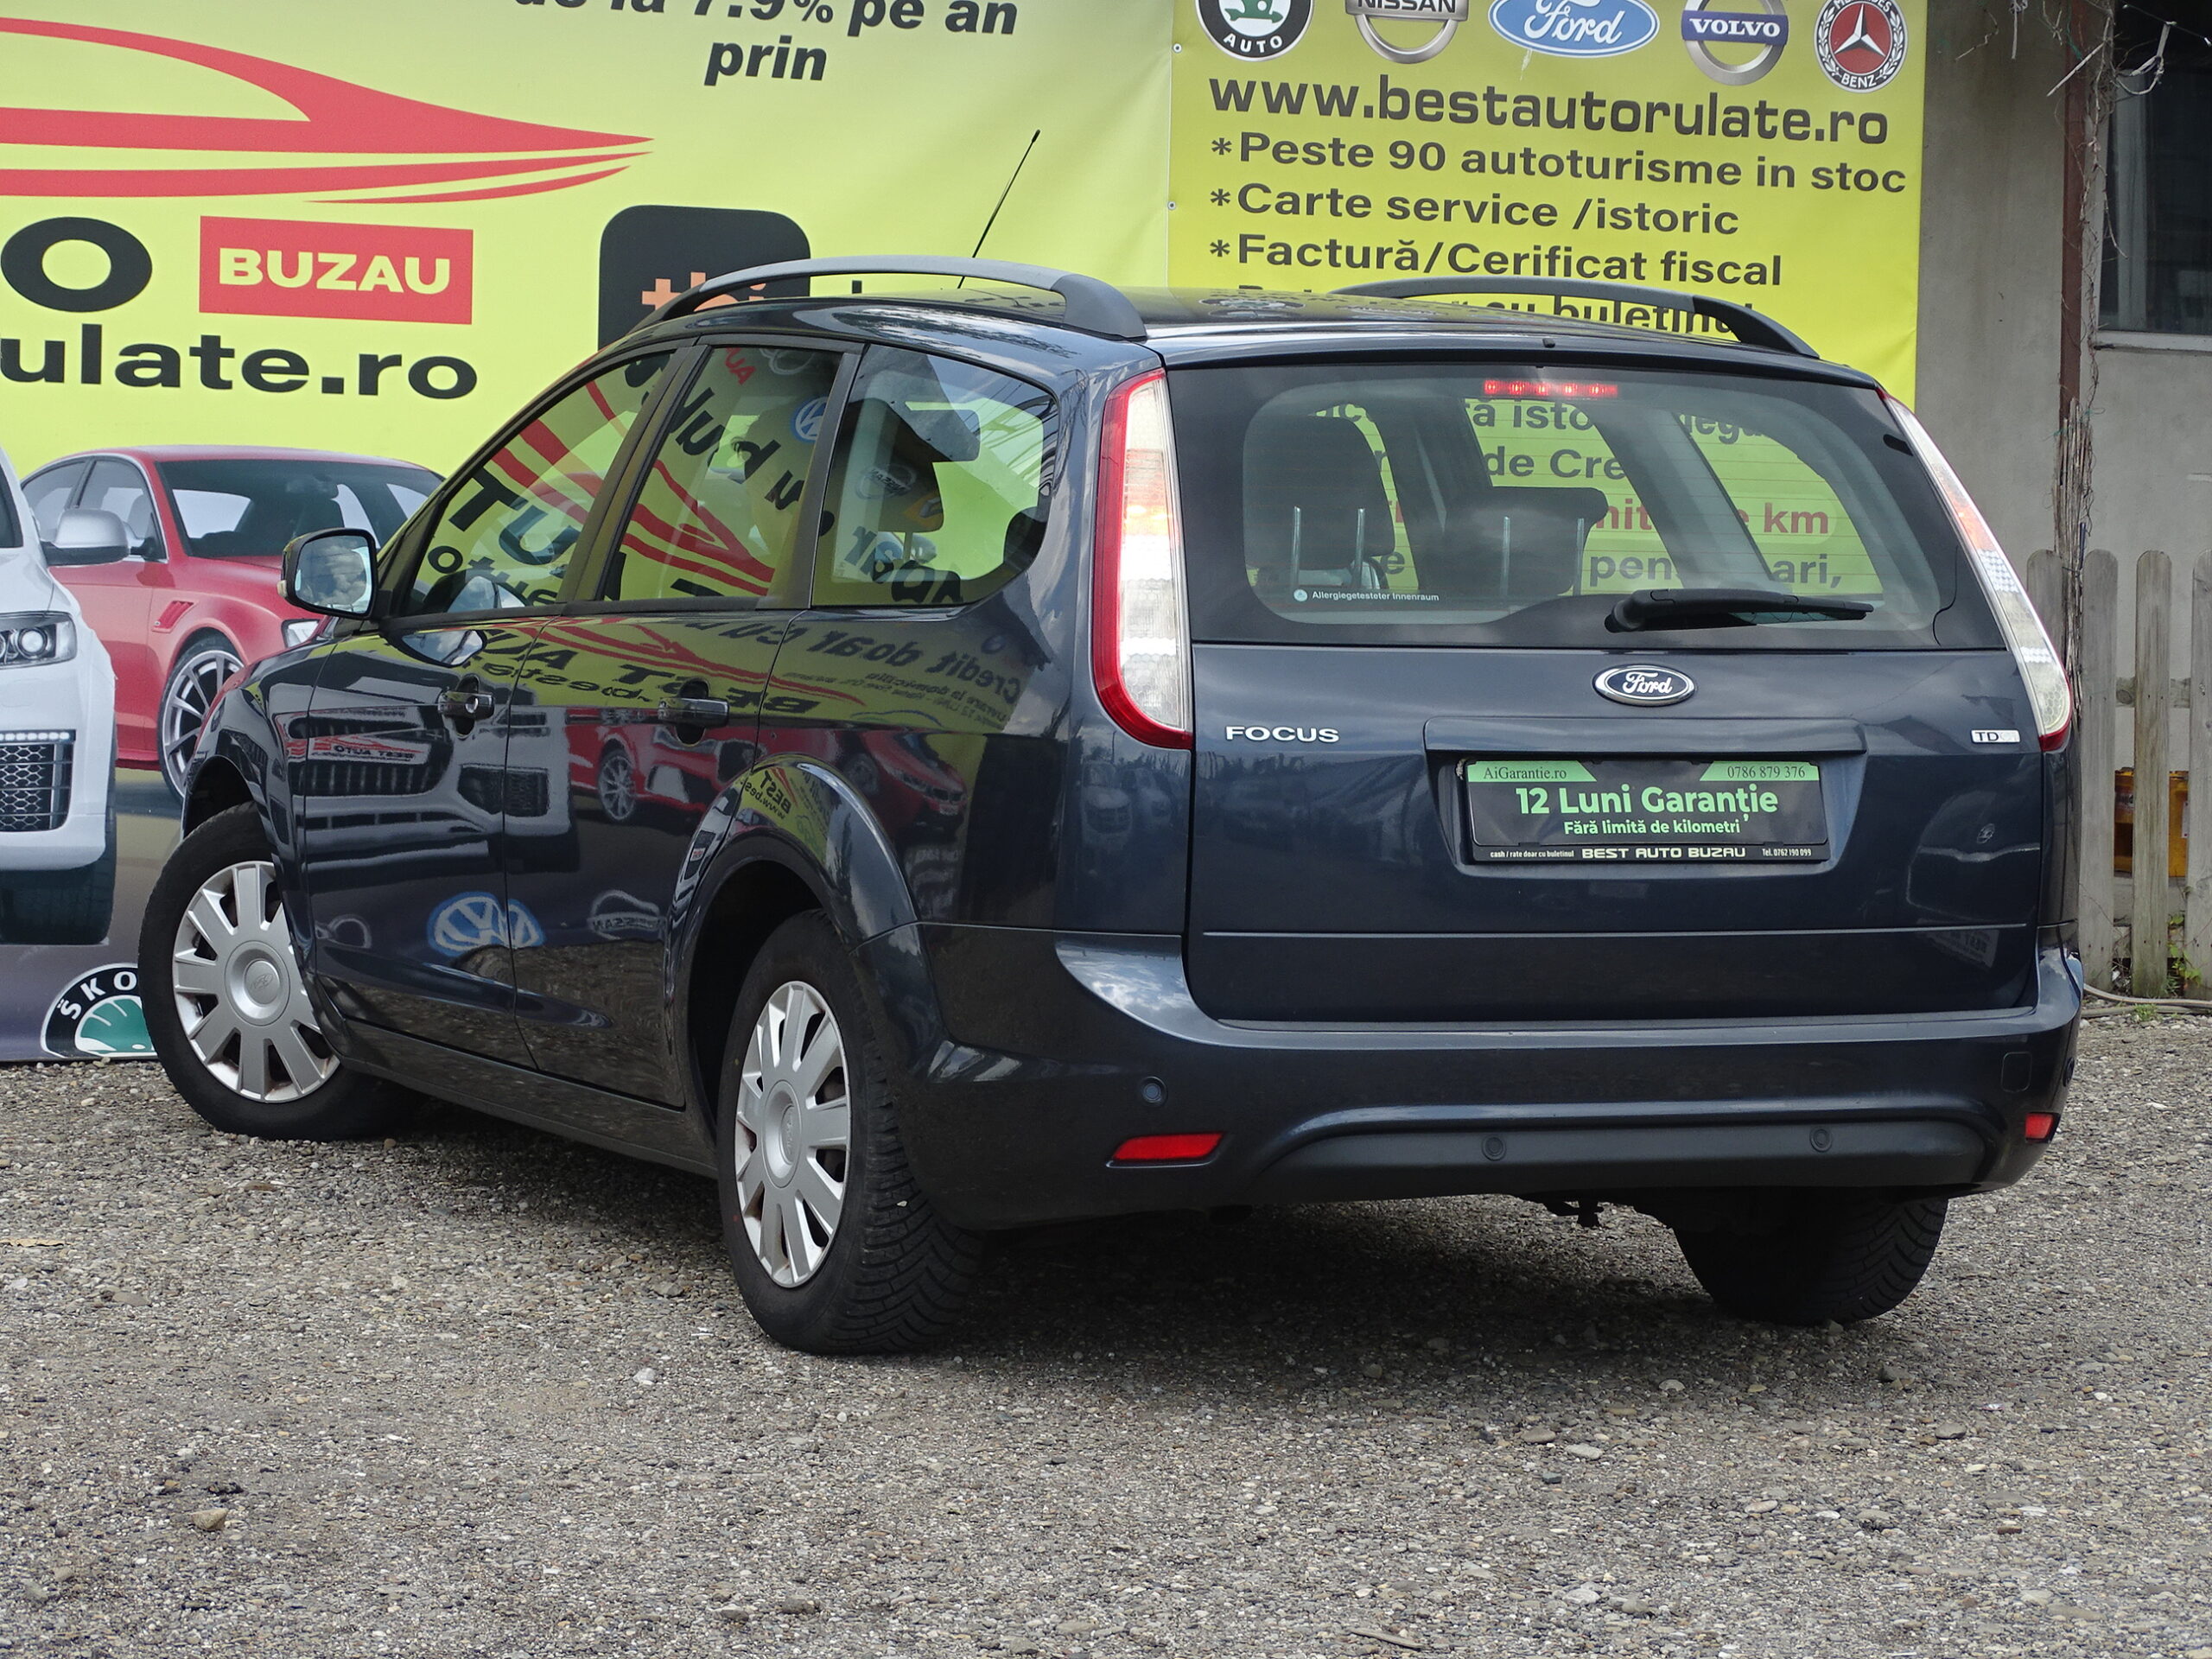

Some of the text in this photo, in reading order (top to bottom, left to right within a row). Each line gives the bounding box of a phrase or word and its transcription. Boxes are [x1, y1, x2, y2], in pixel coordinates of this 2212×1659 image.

[847, 0, 925, 36] pe
[944, 1, 1018, 35] an
[1689, 17, 1782, 39] VOLVO
[1224, 34, 1283, 54] AUTO
[704, 35, 828, 86] prin
[1840, 73, 1877, 89] BENZ
[1208, 73, 1889, 145] www.bestautorulate.ro
[1389, 139, 1446, 171] 90
[1461, 146, 1742, 186] autoturisme
[1757, 156, 1796, 188] in
[1811, 162, 1907, 194] stoc
[1386, 193, 1558, 227] service
[1572, 197, 1739, 235] /istoric
[219, 247, 451, 295] BUZAU
[1660, 250, 1782, 286] fiscal
[1763, 502, 1829, 535] km
[1588, 555, 1673, 588] pen
[1392, 591, 1440, 602] Innenraum
[1623, 671, 1673, 696] Ford
[1225, 726, 1340, 744] FOCUS
[1483, 766, 1567, 780] AiGarantie.ro
[1726, 766, 1806, 779] 0786 879 376
[1516, 787, 1550, 815] 12
[1559, 784, 1631, 814] Luni
[1564, 819, 1740, 835] Fără limită de kilometri
[1523, 849, 1538, 858] doar
[1547, 849, 1574, 858] buletinul
[1581, 848, 1629, 859] BEST
[1635, 847, 1682, 858] AUTO
[1688, 847, 1746, 858] BUZAU
[1762, 848, 1774, 856] Tel.
[1773, 849, 1788, 857] 0762
[1789, 849, 1800, 857] 190
[1800, 849, 1812, 857] 099
[57, 970, 137, 1020] ŠKO
